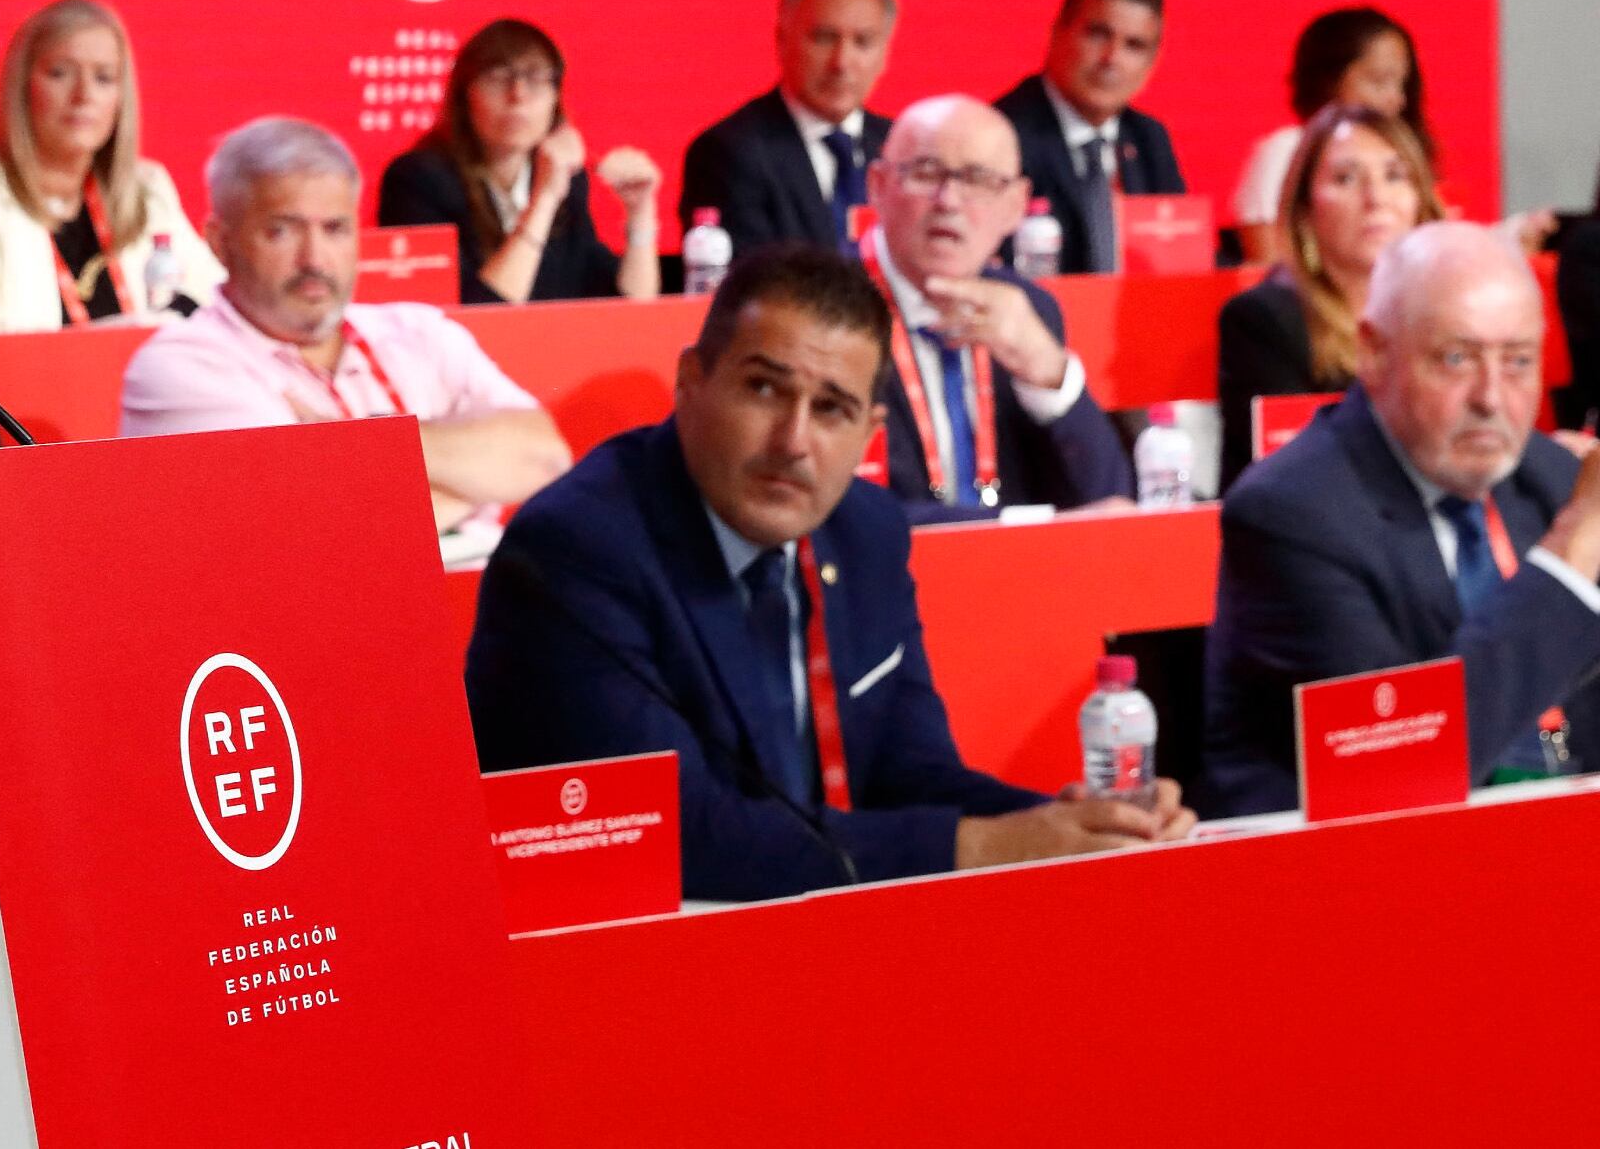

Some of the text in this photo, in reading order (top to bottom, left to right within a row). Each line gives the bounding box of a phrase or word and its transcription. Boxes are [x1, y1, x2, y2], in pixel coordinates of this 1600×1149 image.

[243, 904, 295, 928] REAL
[207, 924, 338, 967] FEDERACIÓN
[225, 958, 332, 995] ESPAÑOLA
[227, 987, 340, 1027] DE FÚTBOL
